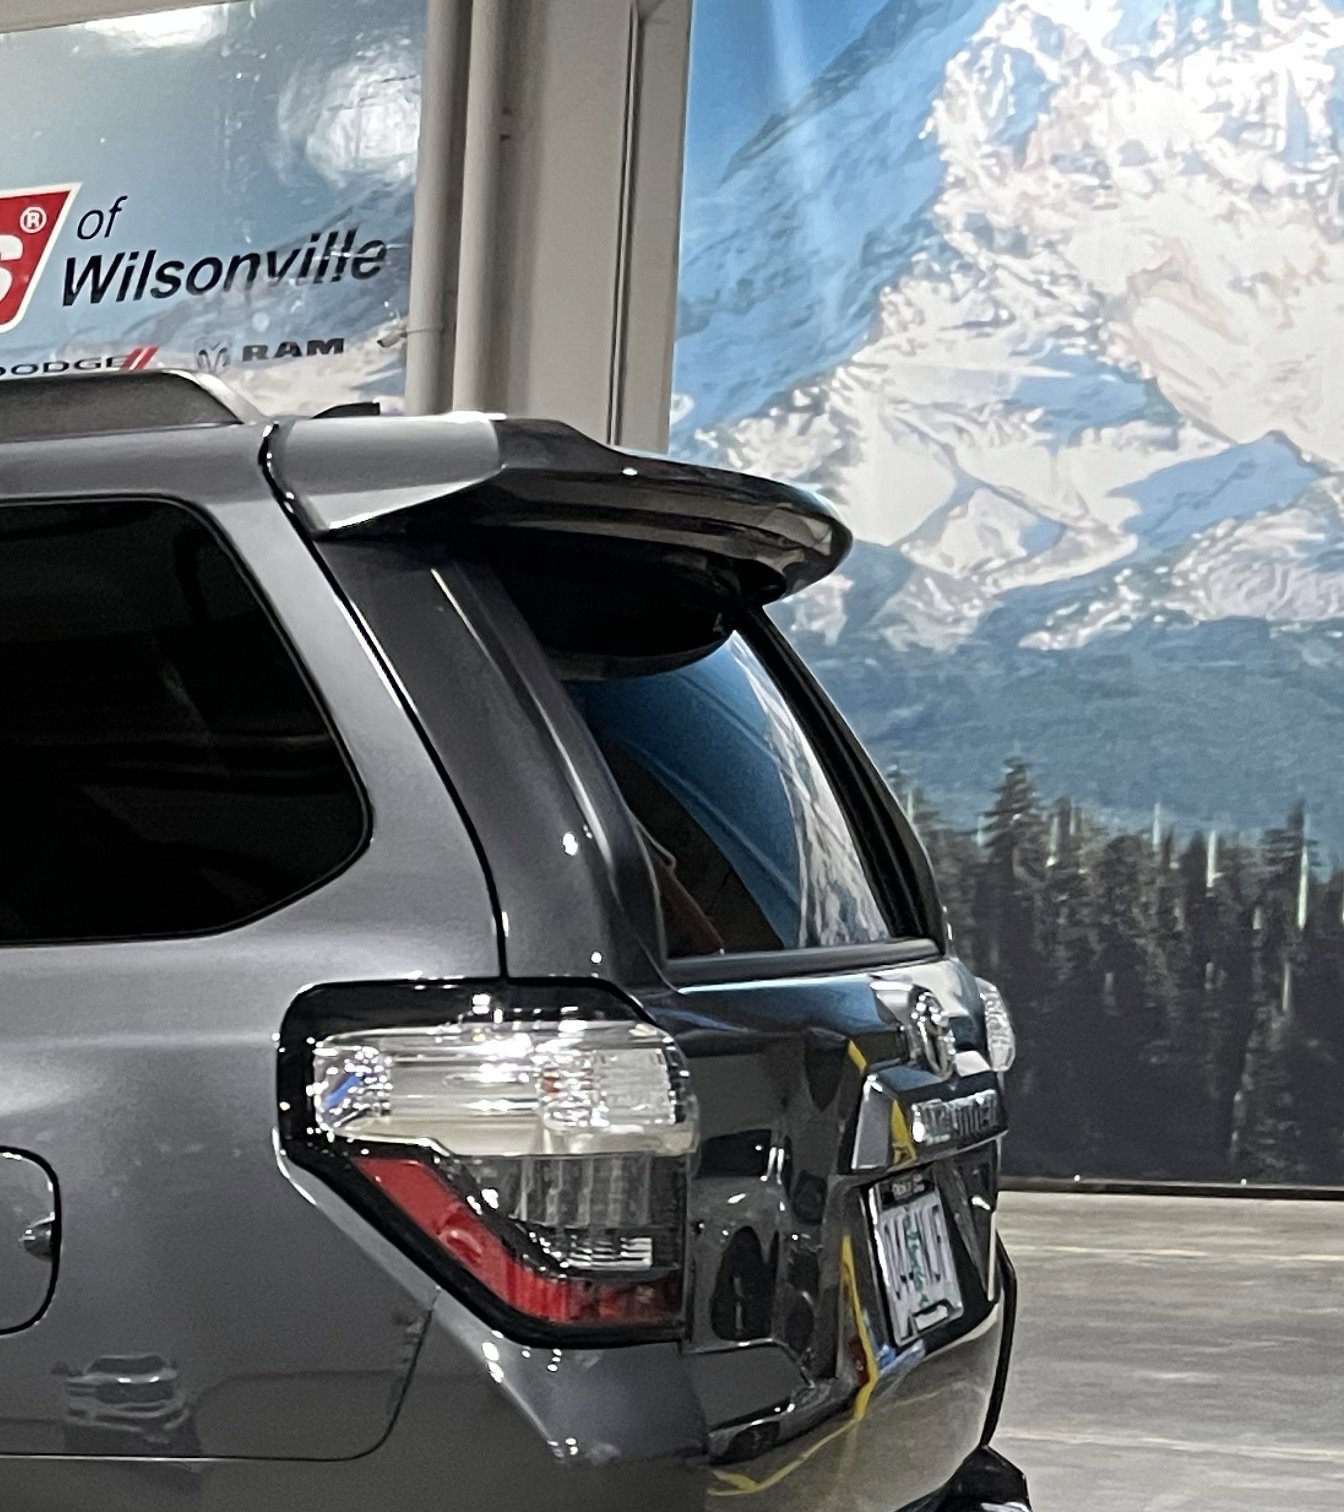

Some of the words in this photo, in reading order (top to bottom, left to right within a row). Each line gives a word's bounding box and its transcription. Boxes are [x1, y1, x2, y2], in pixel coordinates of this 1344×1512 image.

[76, 196, 128, 240] of
[61, 227, 388, 307] Wilsonville
[241, 337, 345, 363] RAM
